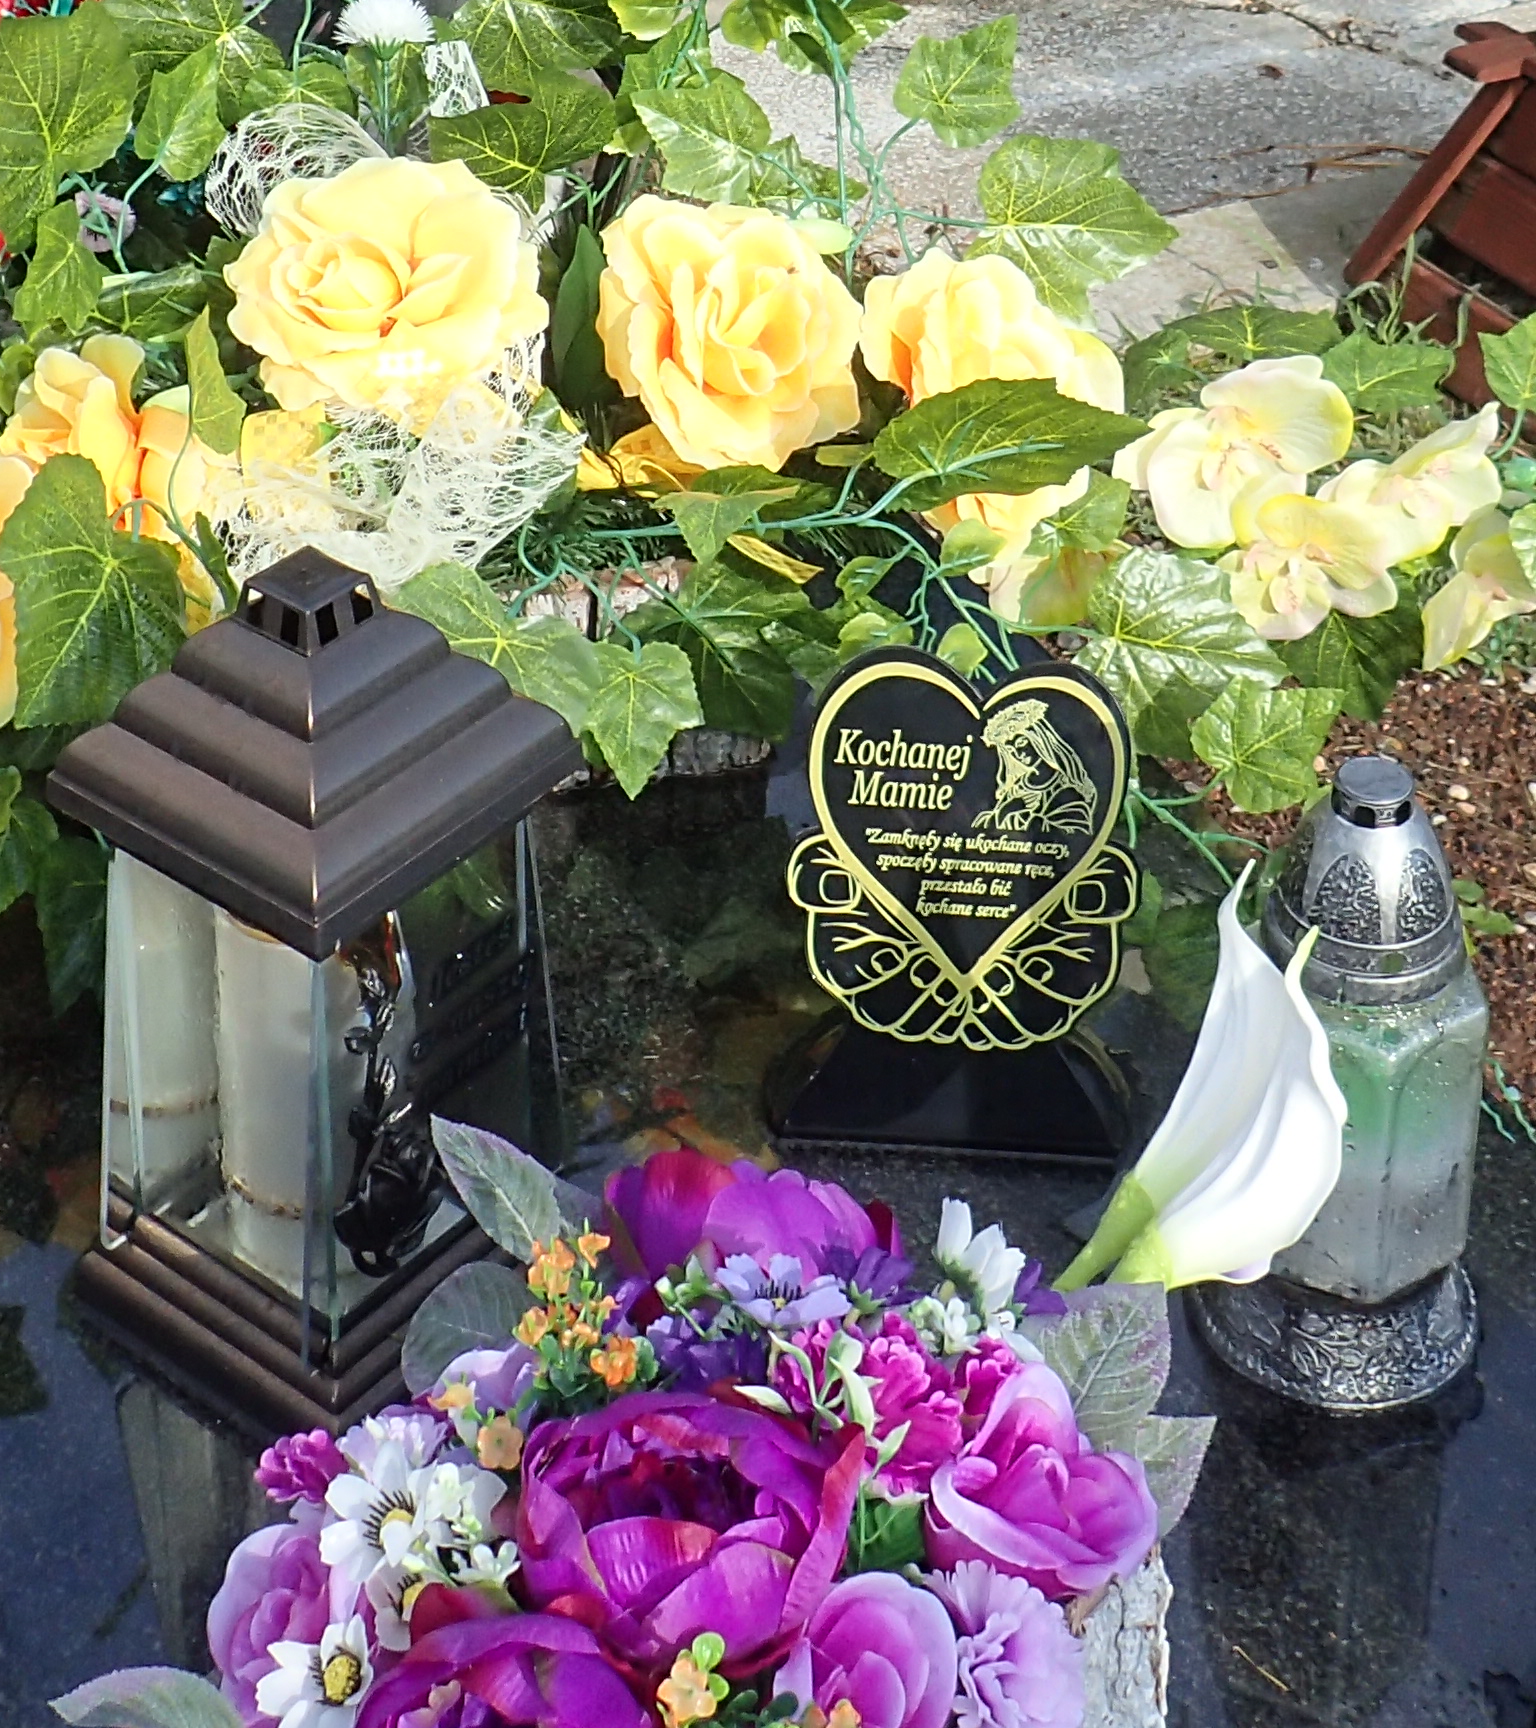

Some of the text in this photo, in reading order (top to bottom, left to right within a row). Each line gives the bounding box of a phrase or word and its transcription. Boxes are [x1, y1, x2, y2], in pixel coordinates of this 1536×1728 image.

[834, 729, 974, 780] Kochanej
[848, 770, 955, 811] Mamie
[943, 833, 962, 853] się
[965, 834, 1032, 854] ukochane
[939, 858, 1022, 875] spracowane
[915, 896, 974, 917] kochane
